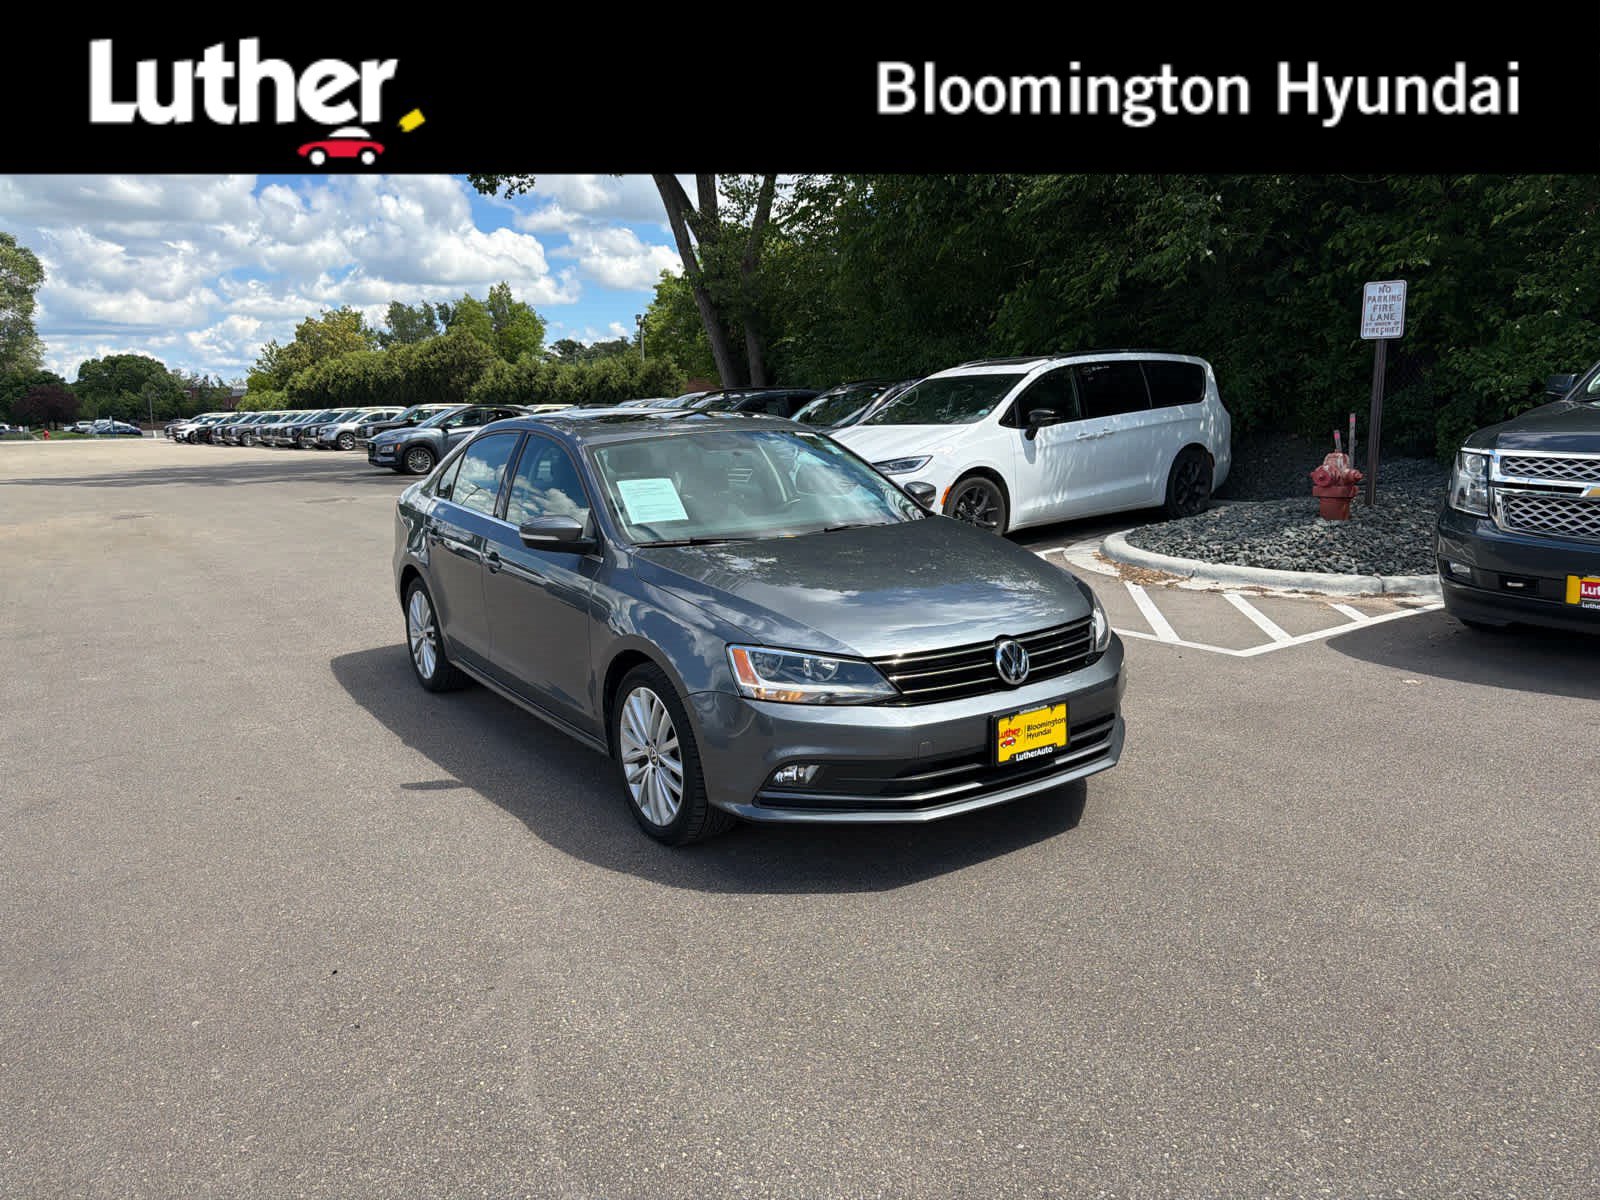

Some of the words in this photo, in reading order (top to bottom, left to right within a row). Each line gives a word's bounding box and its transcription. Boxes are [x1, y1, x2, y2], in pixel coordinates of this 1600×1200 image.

[1378, 286, 1391, 294] NO
[1367, 295, 1402, 303] PARKING
[1372, 304, 1394, 312] FIRE
[1370, 313, 1396, 321] LANE
[1026, 717, 1066, 732] Bloomington
[1026, 728, 1052, 740] Hyundai
[1015, 746, 1053, 762] LutherAuto
